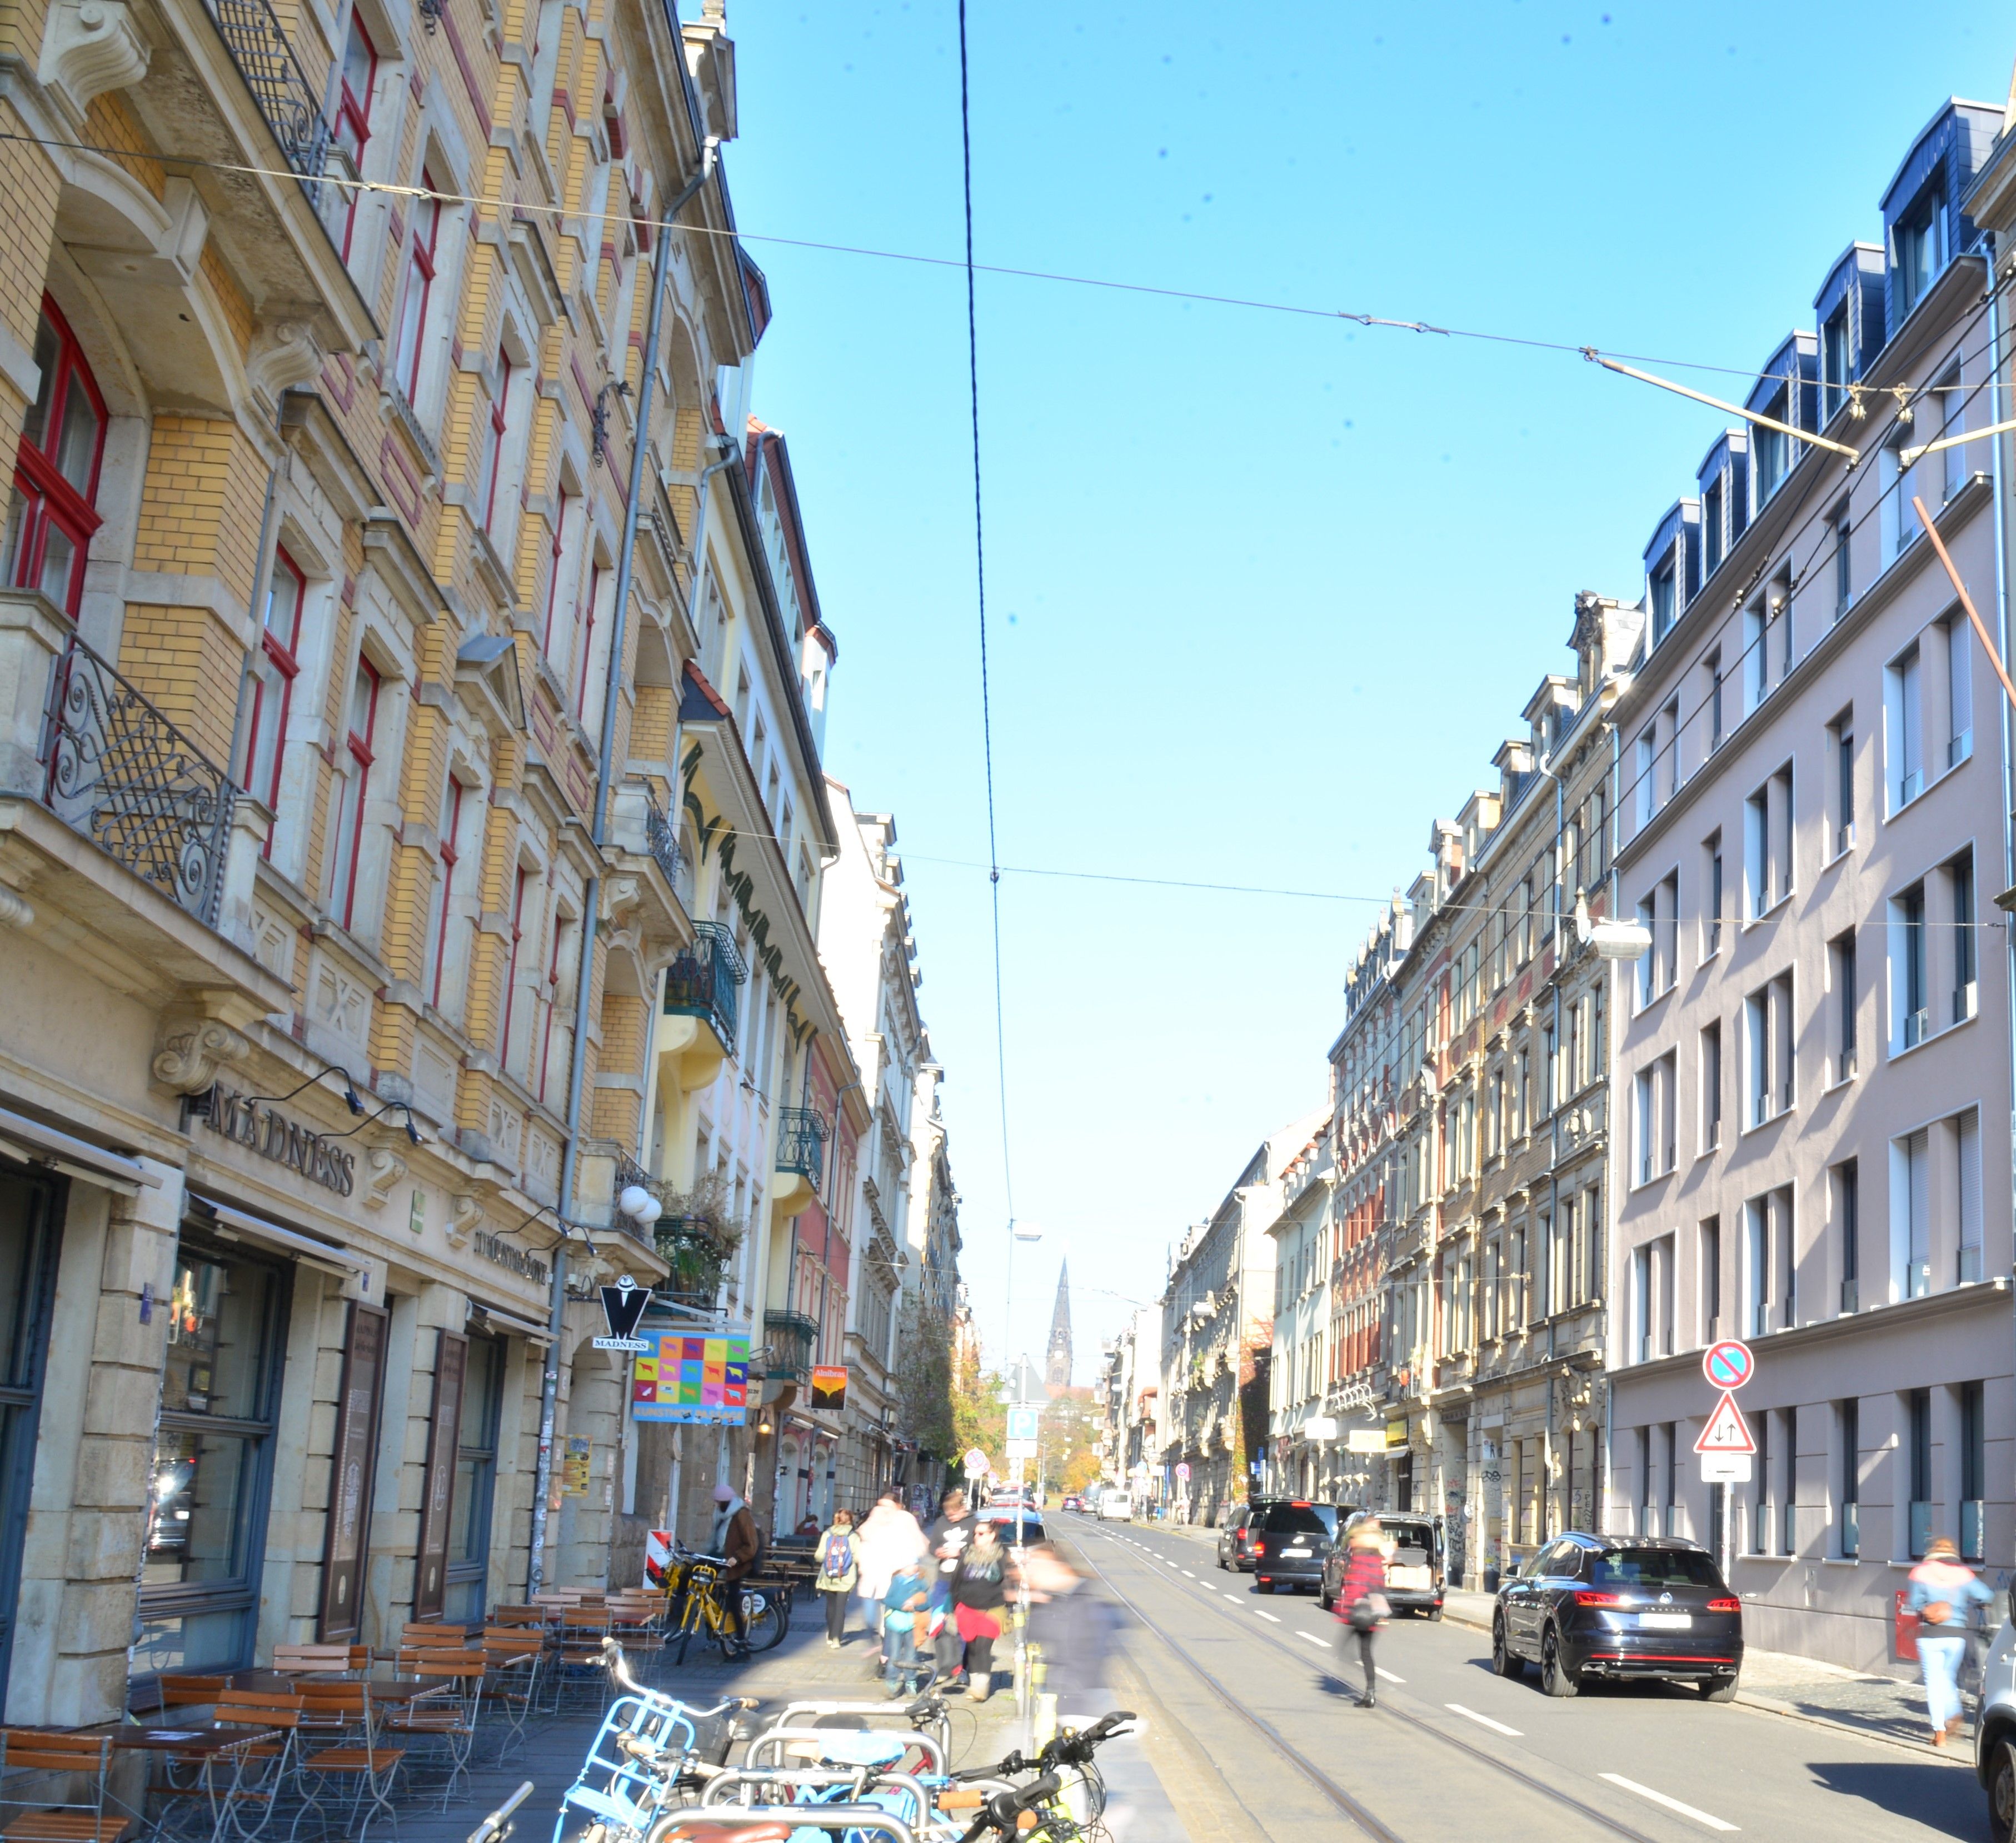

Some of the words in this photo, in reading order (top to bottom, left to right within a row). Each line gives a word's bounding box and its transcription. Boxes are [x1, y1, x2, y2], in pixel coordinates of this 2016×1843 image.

[203, 1080, 355, 1197] MADNESS
[596, 1340, 646, 1349] MADNESS
[1014, 1412, 1032, 1435] P
